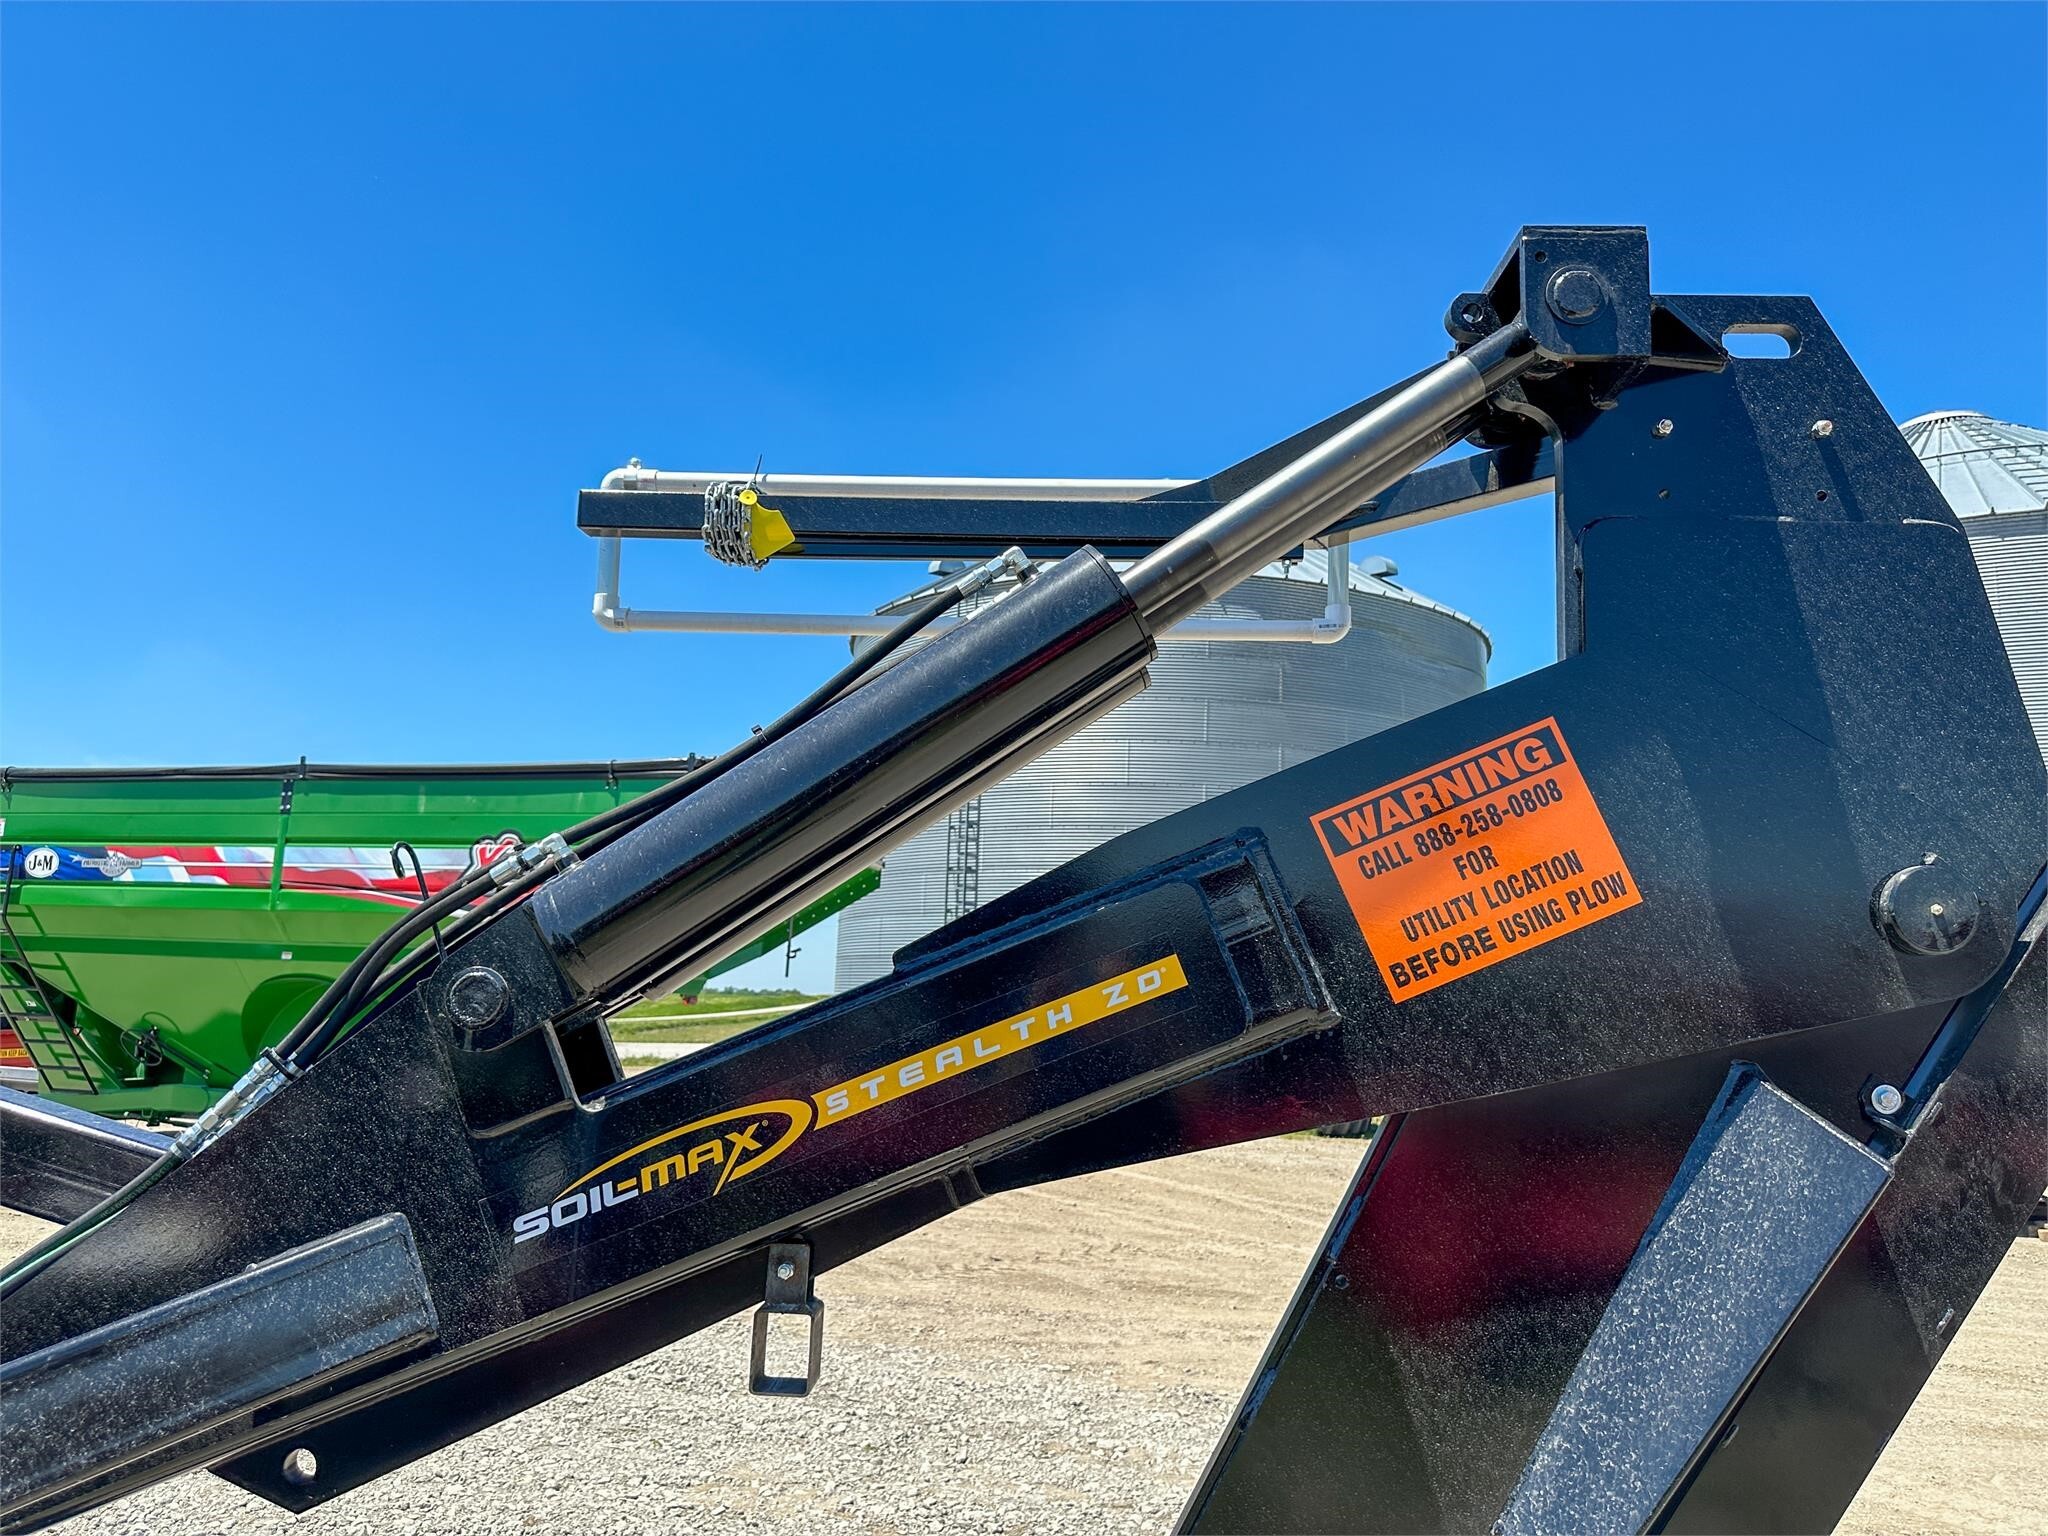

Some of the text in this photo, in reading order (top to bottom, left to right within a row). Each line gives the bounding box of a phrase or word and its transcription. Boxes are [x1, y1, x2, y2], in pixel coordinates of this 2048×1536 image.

[1332, 738, 1553, 847] WARNING
[1357, 778, 1563, 879] CALL 888-258-0808
[29, 854, 53, 871] J&M
[1400, 849, 1584, 942] UTILITY LOCATION
[1453, 845, 1499, 880] FOR
[1388, 870, 1628, 989] BEFORE USING PLOW
[826, 1003, 1073, 1115] STEALTH
